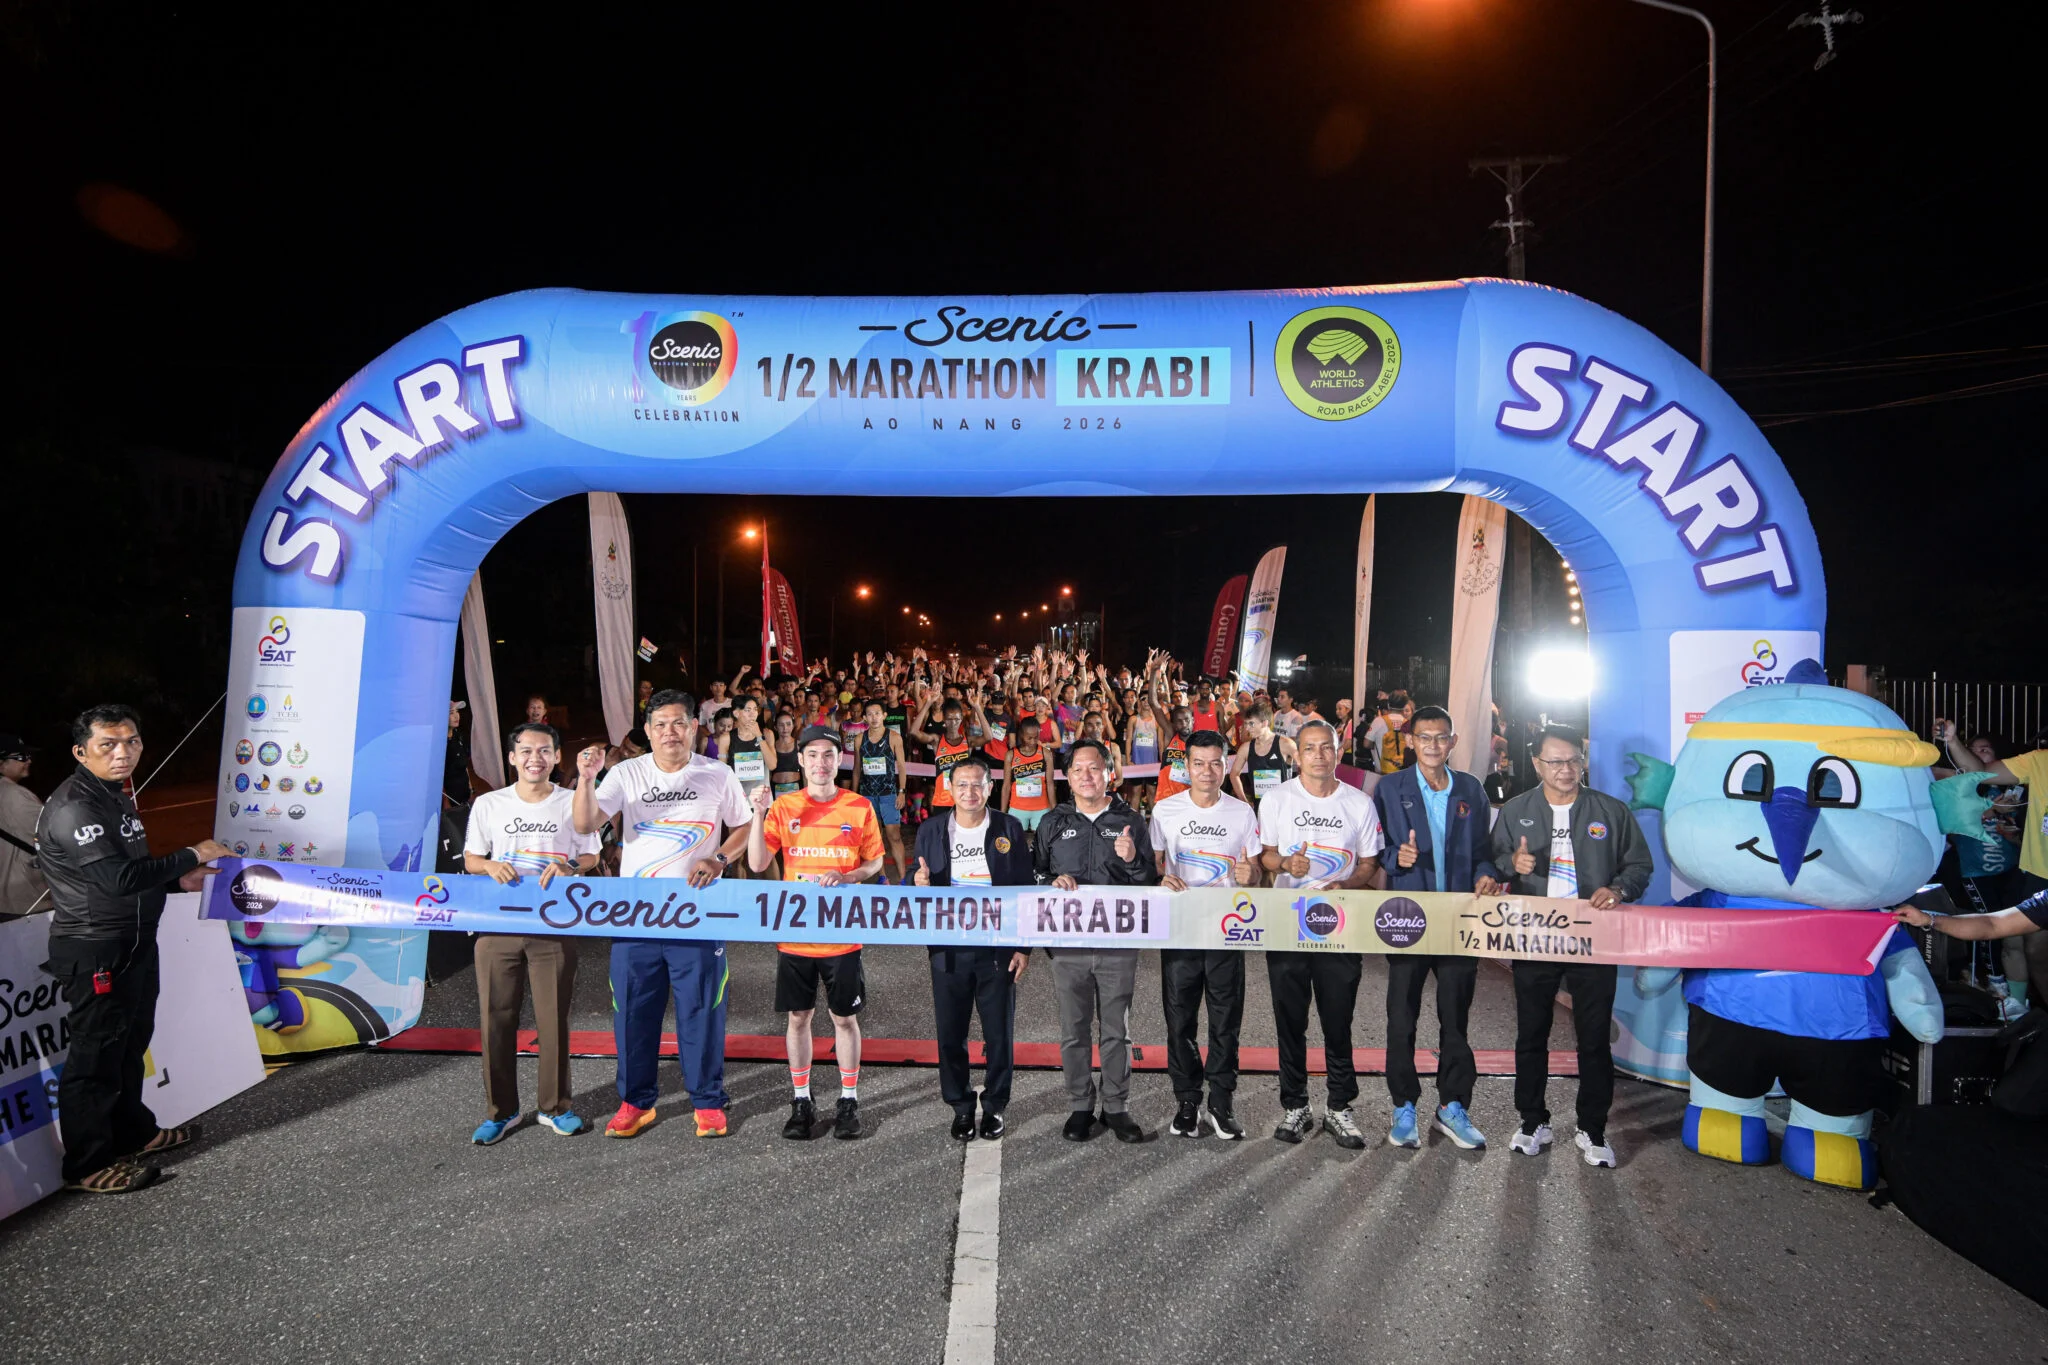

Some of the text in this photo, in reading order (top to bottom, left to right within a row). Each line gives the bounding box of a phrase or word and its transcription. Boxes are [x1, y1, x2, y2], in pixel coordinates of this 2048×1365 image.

[904, 306, 1091, 346] Scenic
[651, 338, 721, 360] Scenic
[757, 354, 1210, 401] 1/2 MARATHON KRABI
[1317, 337, 1396, 416] ROAD RACE LABEL 2026
[1319, 369, 1357, 379] WORLD
[1309, 379, 1365, 389] ATHLETICS
[634, 408, 740, 422] CELEBRATION
[863, 418, 1122, 430] AO NANG 2026
[262, 337, 522, 579] START
[1499, 345, 1794, 591] START
[260, 649, 297, 662] SAT
[641, 786, 698, 803] Scenic
[504, 817, 559, 834] Scenic
[1294, 810, 1344, 829] Scenic
[1180, 820, 1228, 837] Scenic
[788, 846, 850, 858] GATORADE
[950, 843, 986, 859] Scen
[327, 872, 370, 886] Scenic
[246, 901, 263, 910] 2026
[539, 882, 701, 929] Scenic
[755, 889, 1149, 934] 1/2 MARATHON KRABI
[416, 909, 458, 922] SAT
[1305, 912, 1339, 923] Scenic
[1375, 912, 1427, 928] Scenic
[1482, 902, 1570, 929] Scenic
[1225, 928, 1265, 941] SAT
[1391, 934, 1409, 942] 2026
[1487, 932, 1592, 956] MARATHON
